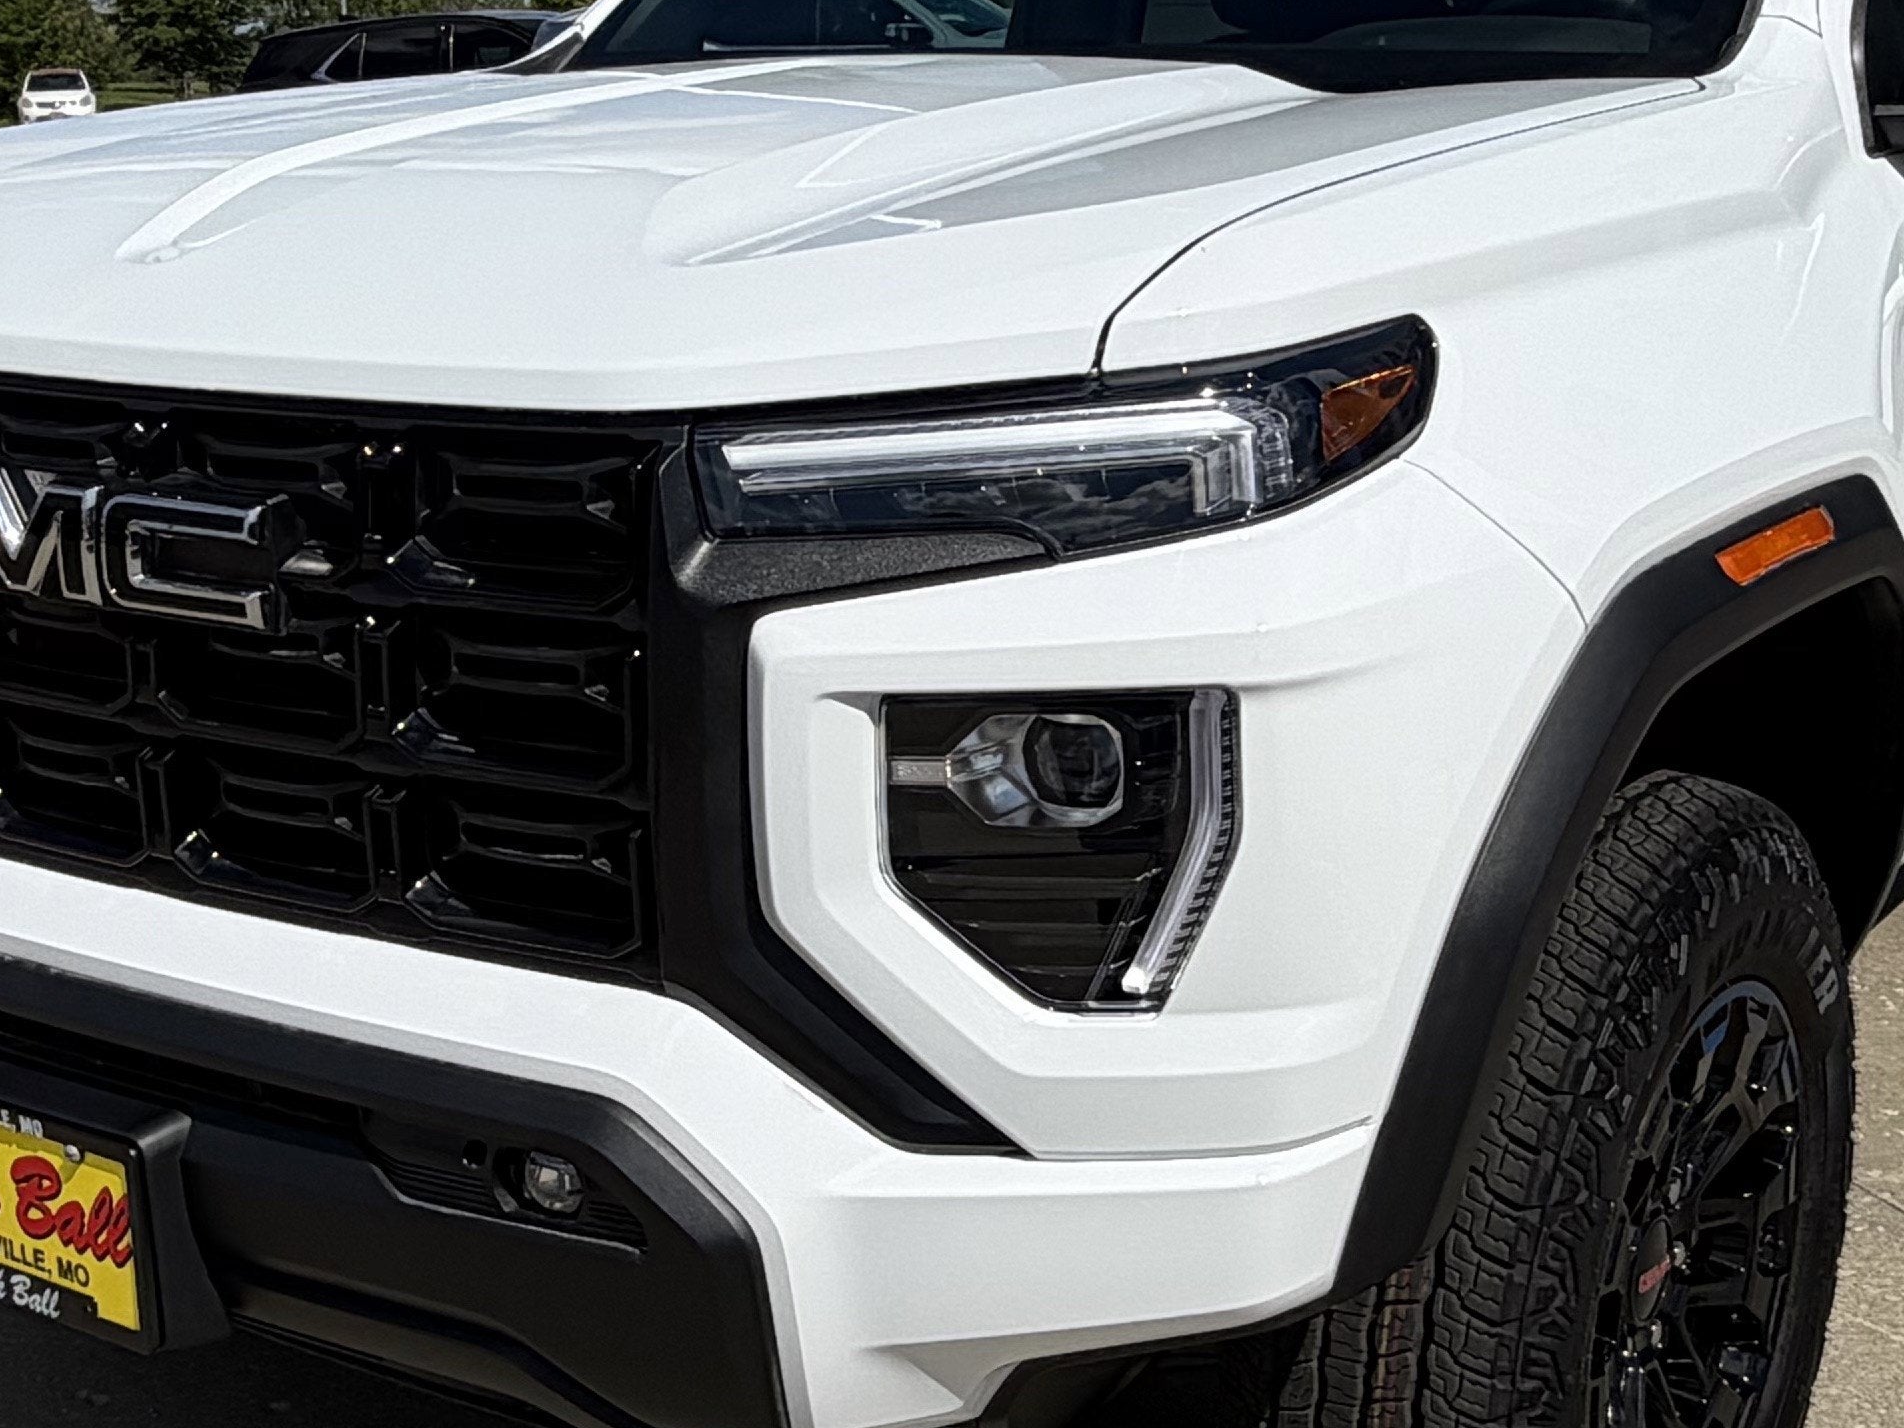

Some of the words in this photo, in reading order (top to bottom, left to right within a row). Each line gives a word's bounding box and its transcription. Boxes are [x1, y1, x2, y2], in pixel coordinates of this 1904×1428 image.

[18, 1114, 45, 1139] MO
[10, 1154, 134, 1269] Ball
[57, 1255, 91, 1288] MO
[10, 1274, 61, 1320] Ball
